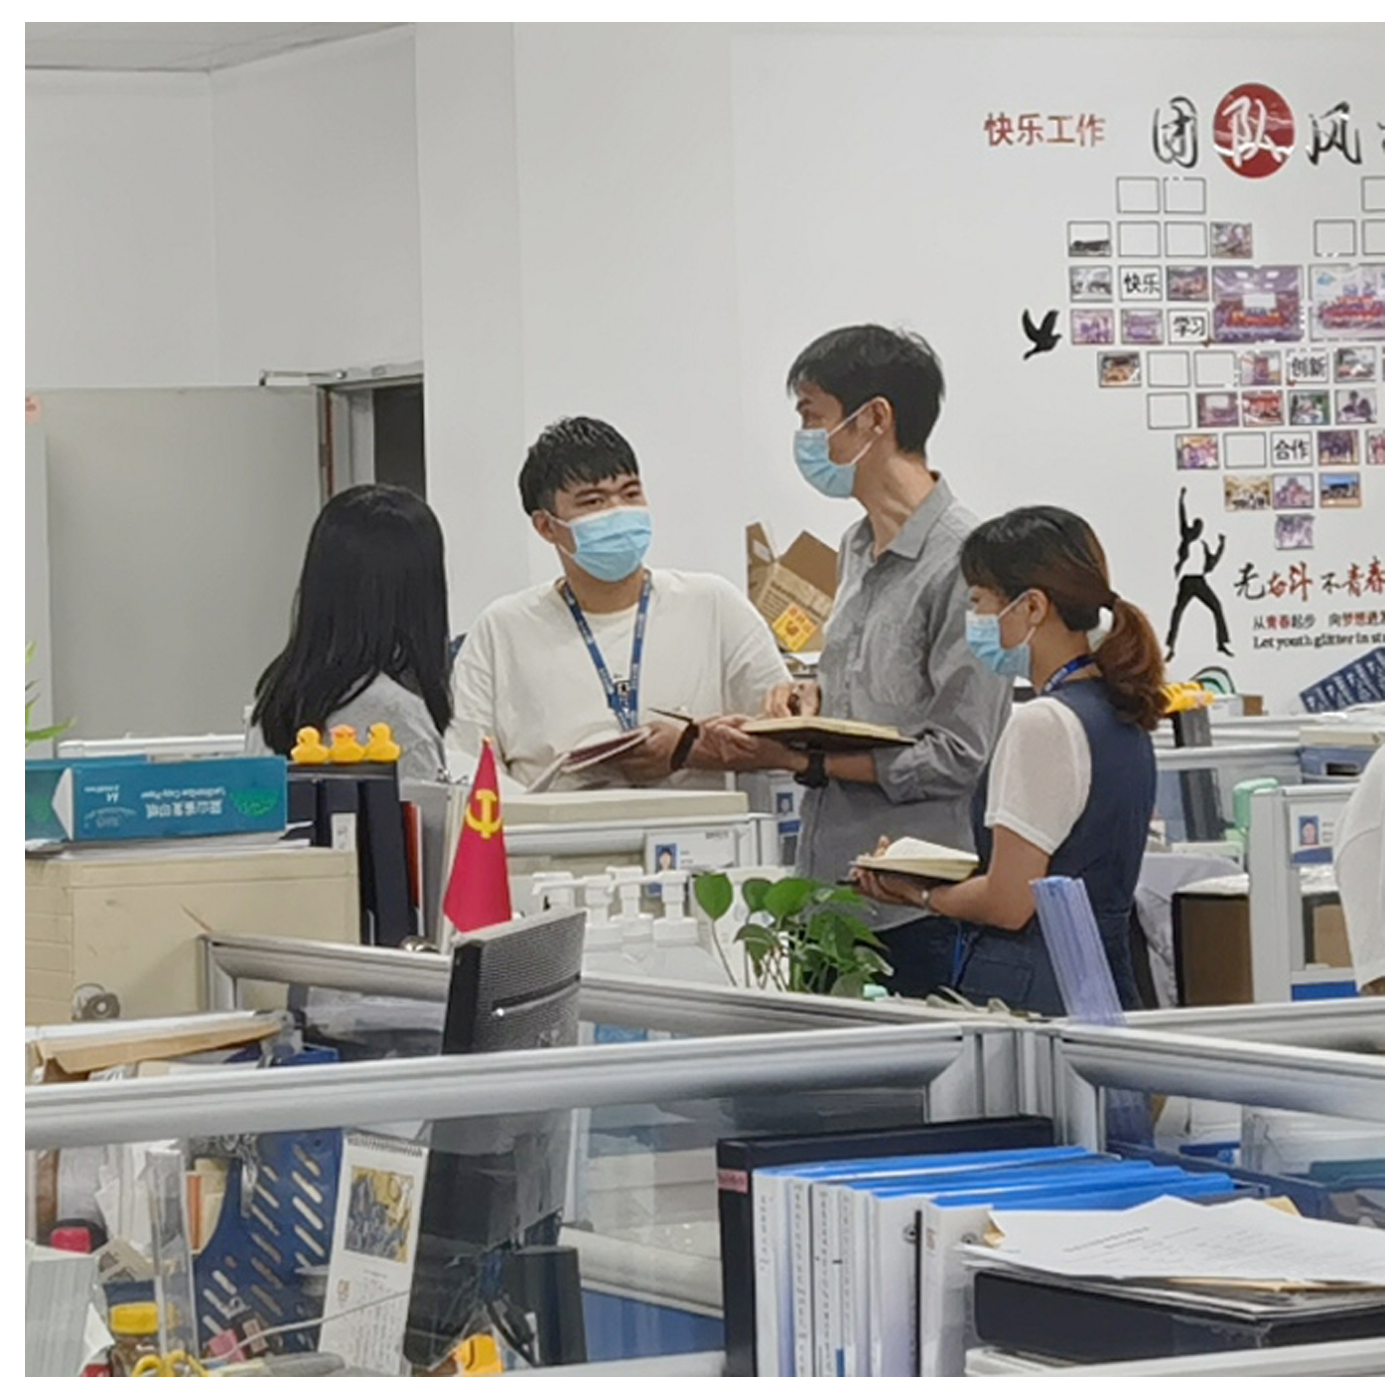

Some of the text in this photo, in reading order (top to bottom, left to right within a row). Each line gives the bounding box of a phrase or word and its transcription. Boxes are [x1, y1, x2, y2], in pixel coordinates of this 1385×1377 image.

[983, 94, 1385, 170] 快乐工作 团队风
[1123, 272, 1161, 295] 快乐
[1172, 315, 1207, 339] 学习
[1290, 355, 1327, 379] 创新
[1273, 437, 1310, 461] 合作
[1253, 635, 1274, 649] Let
[1276, 634, 1313, 651] youth
[1314, 632, 1353, 648] glitter
[1355, 632, 1369, 644] in
